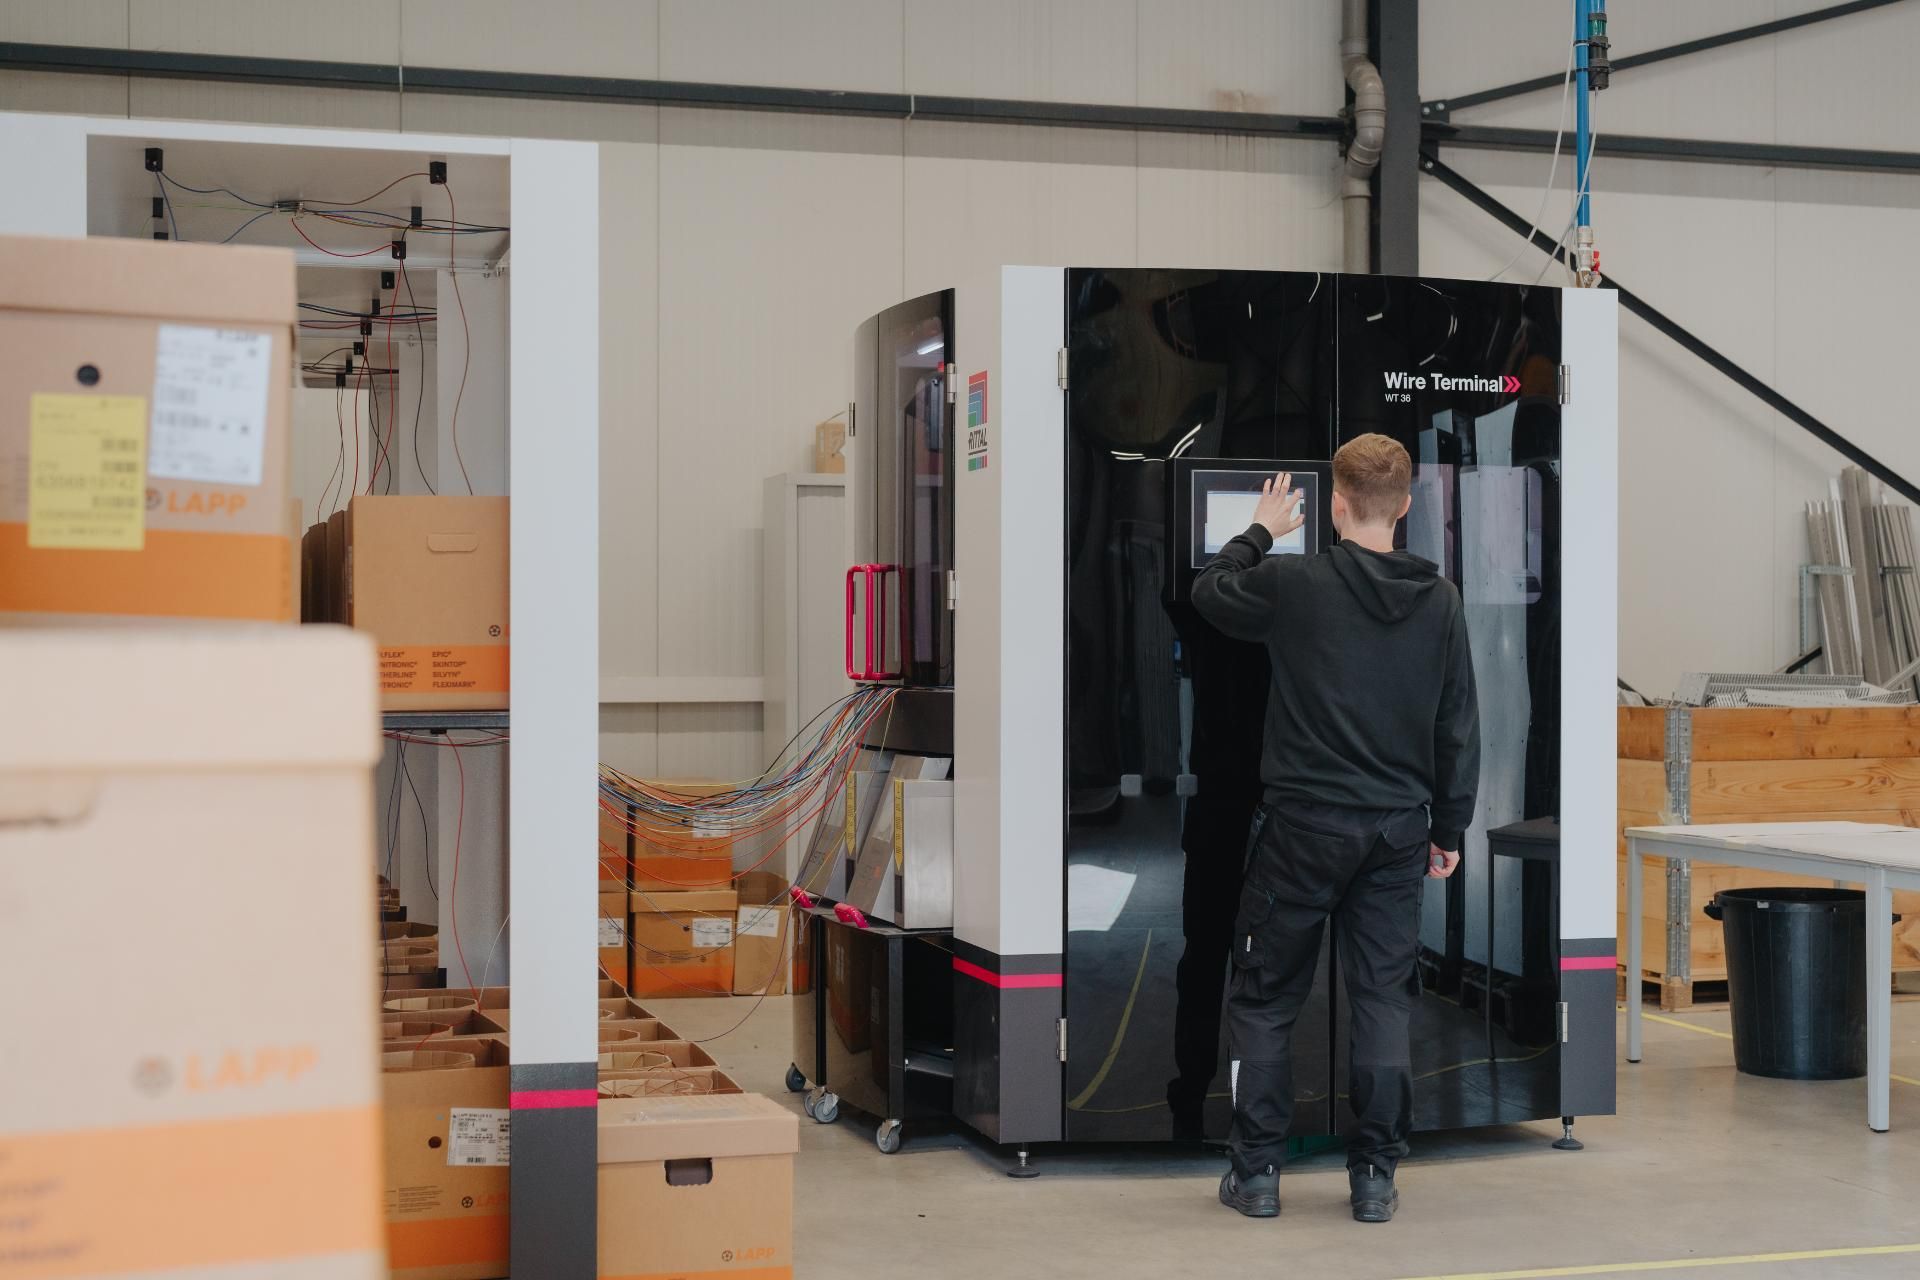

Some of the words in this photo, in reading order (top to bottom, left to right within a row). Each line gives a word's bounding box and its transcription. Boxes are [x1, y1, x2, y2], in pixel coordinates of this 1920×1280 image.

[1384, 372, 1426, 389] Wire
[1431, 373, 1503, 393] Terminal
[1385, 394, 1399, 403] WT
[1401, 394, 1411, 403] 36
[968, 428, 987, 450] RITTAL
[167, 490, 248, 517] LAPP
[182, 1042, 319, 1092] LAPP
[736, 1248, 776, 1261] LAPP
